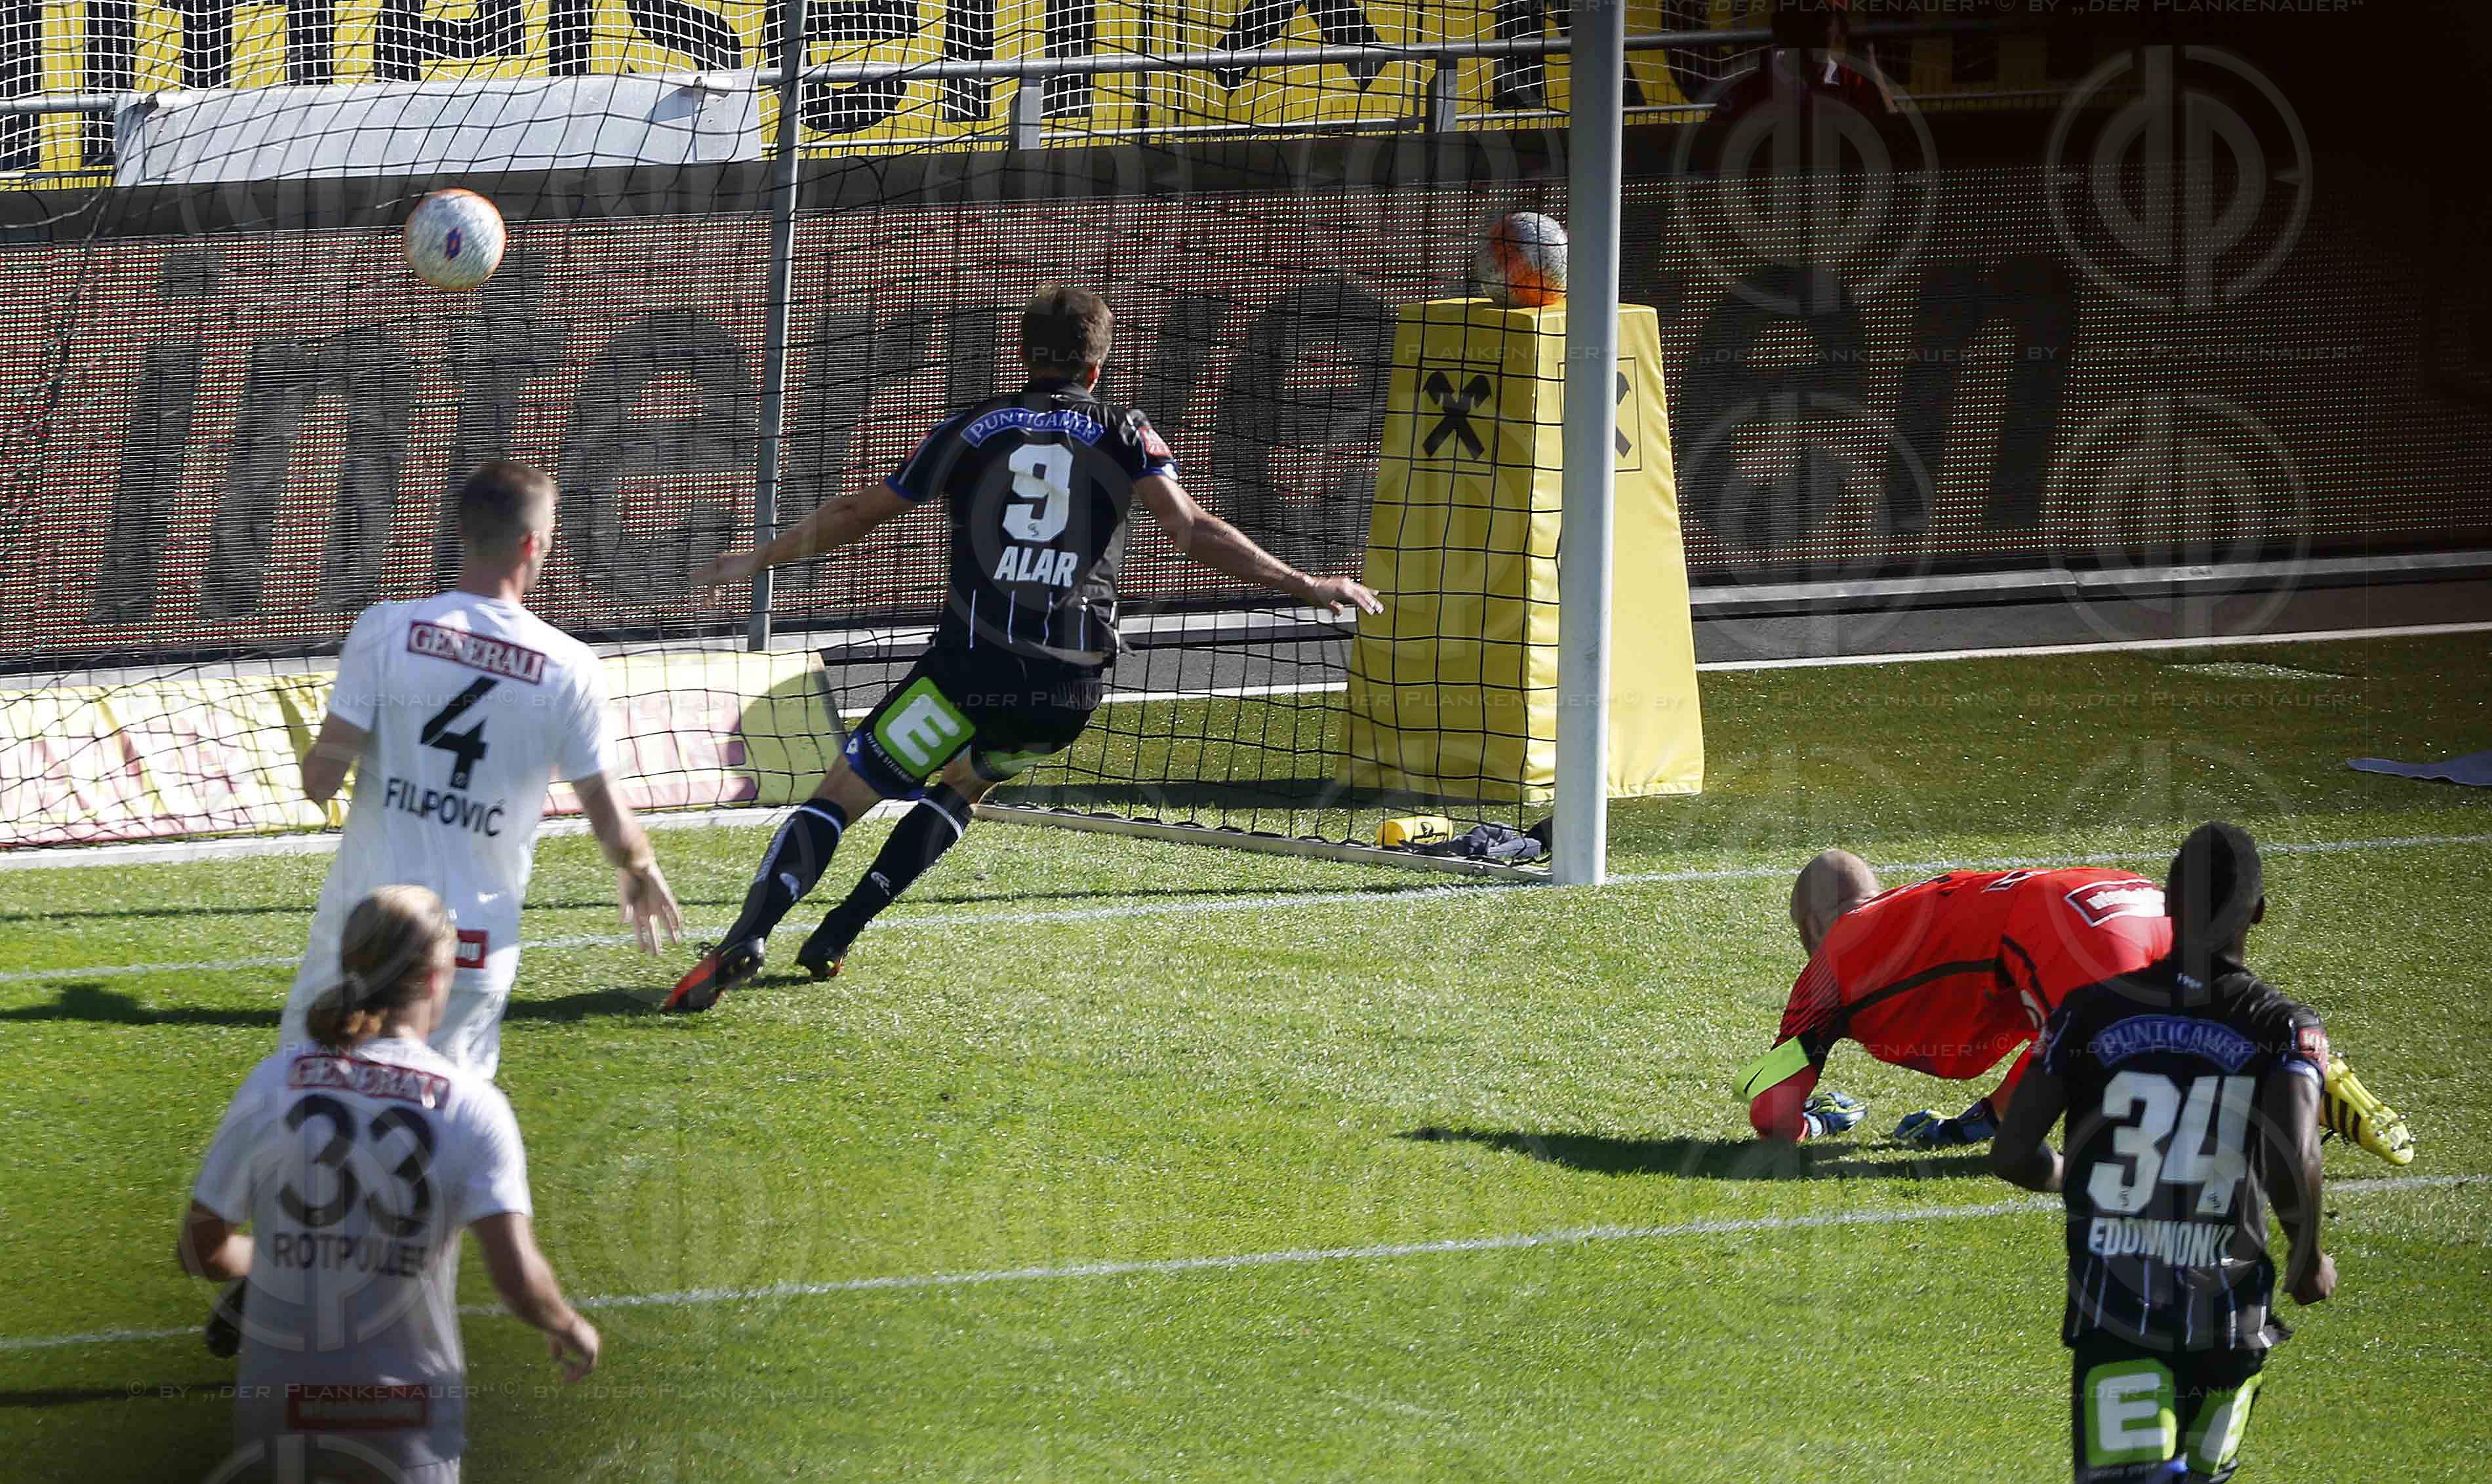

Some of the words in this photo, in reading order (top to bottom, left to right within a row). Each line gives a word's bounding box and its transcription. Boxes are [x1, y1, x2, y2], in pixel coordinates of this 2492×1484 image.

[968, 410, 1098, 441] PUNTIGAMER
[1002, 443, 1075, 542] 9
[993, 546, 1079, 588] ALAR
[411, 625, 544, 683] GENERALI
[420, 675, 501, 790] 4
[277, 1094, 439, 1239] 33
[2087, 1070, 2256, 1216] 34
